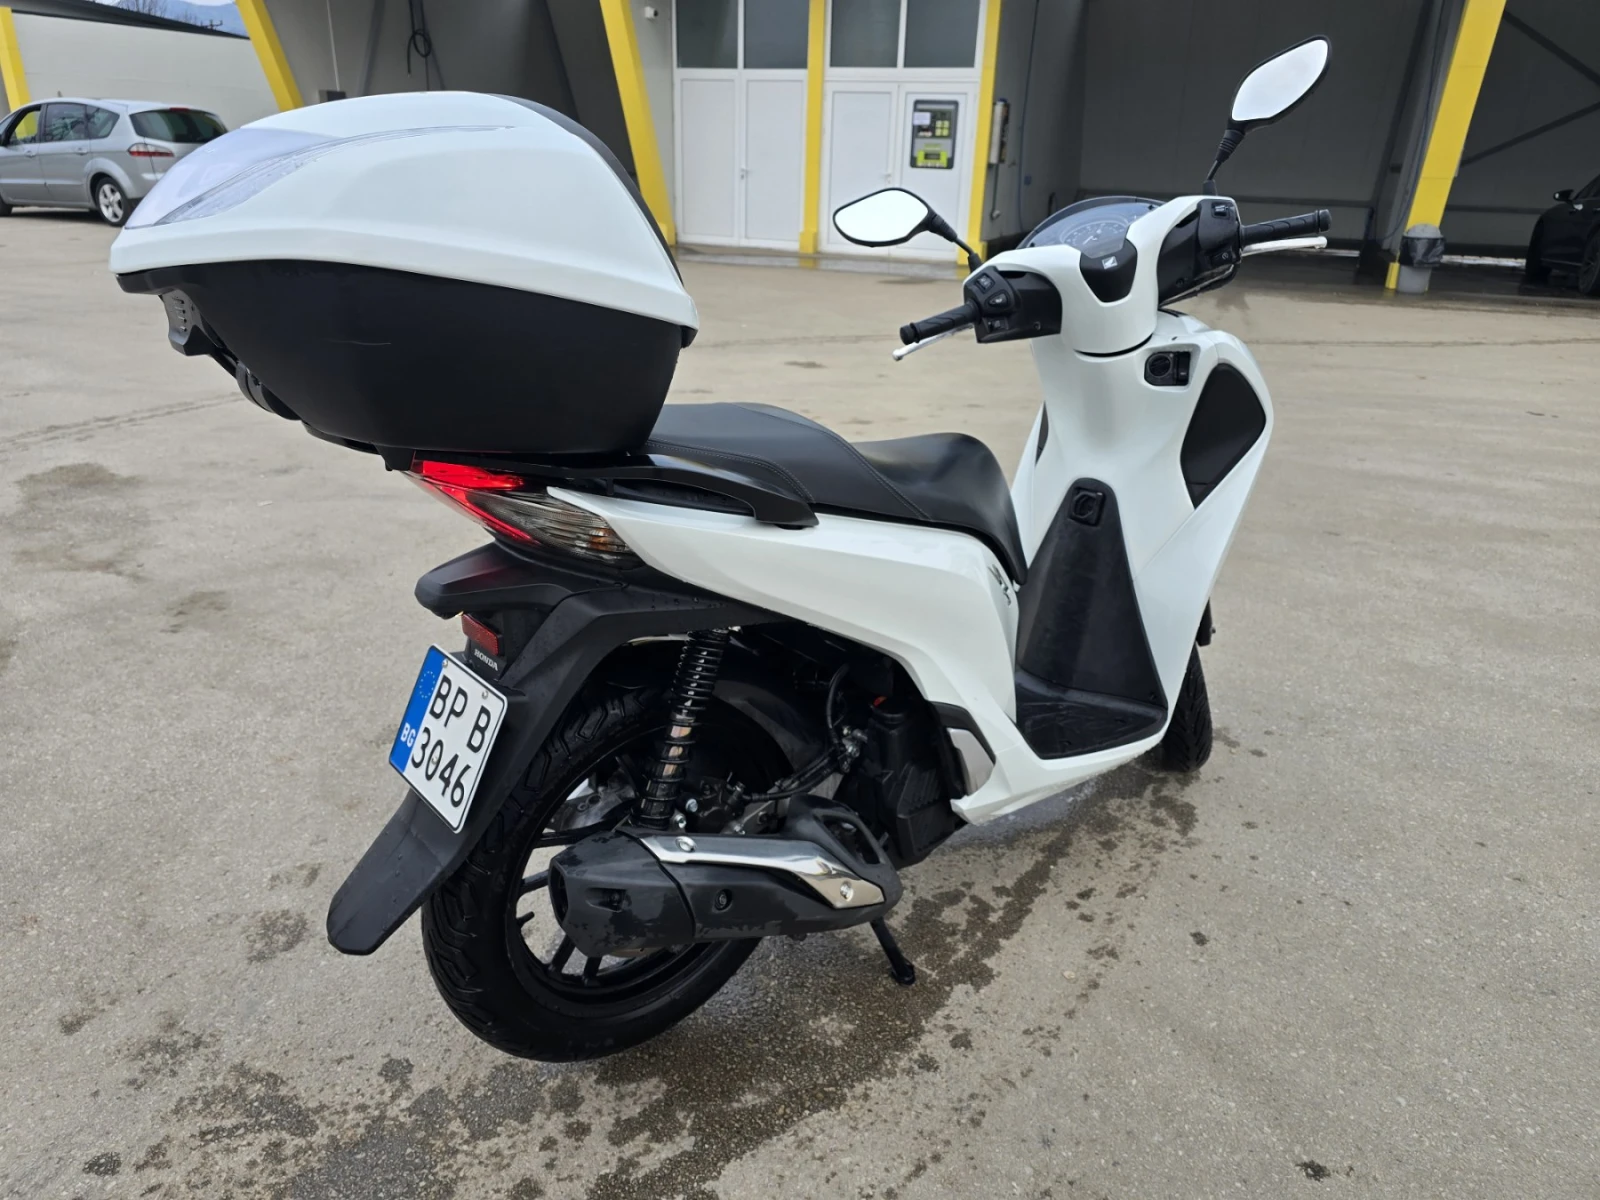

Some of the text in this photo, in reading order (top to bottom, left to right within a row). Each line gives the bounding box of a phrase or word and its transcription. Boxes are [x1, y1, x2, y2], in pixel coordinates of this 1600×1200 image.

[474, 649, 498, 671] HONDA
[401, 723, 416, 747] BG
[429, 675, 491, 753] BP B
[411, 727, 471, 807] 3046
